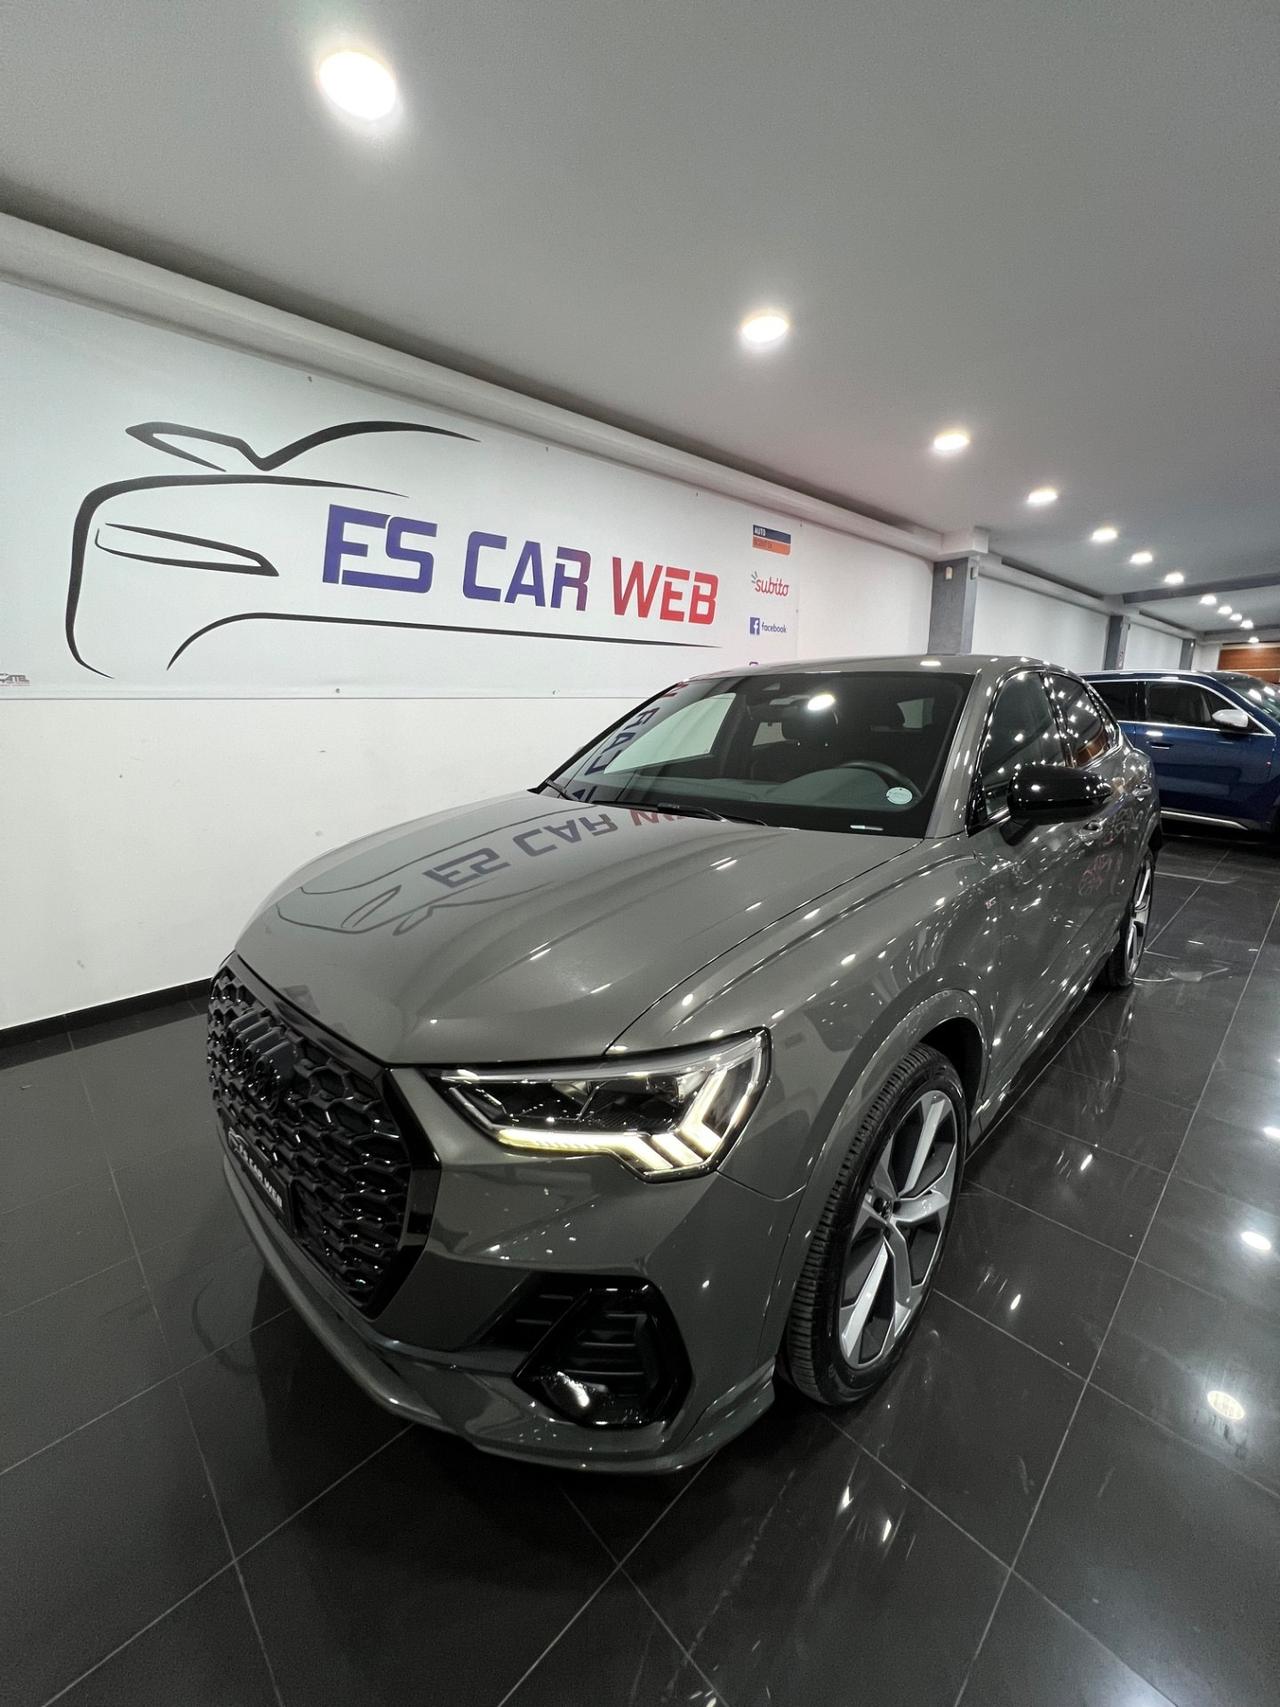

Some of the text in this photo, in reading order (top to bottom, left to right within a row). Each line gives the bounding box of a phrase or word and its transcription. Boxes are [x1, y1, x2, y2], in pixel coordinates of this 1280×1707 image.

[322, 504, 720, 626] ES CAR WEB
[754, 576, 789, 597] subito
[761, 621, 787, 633] facebook
